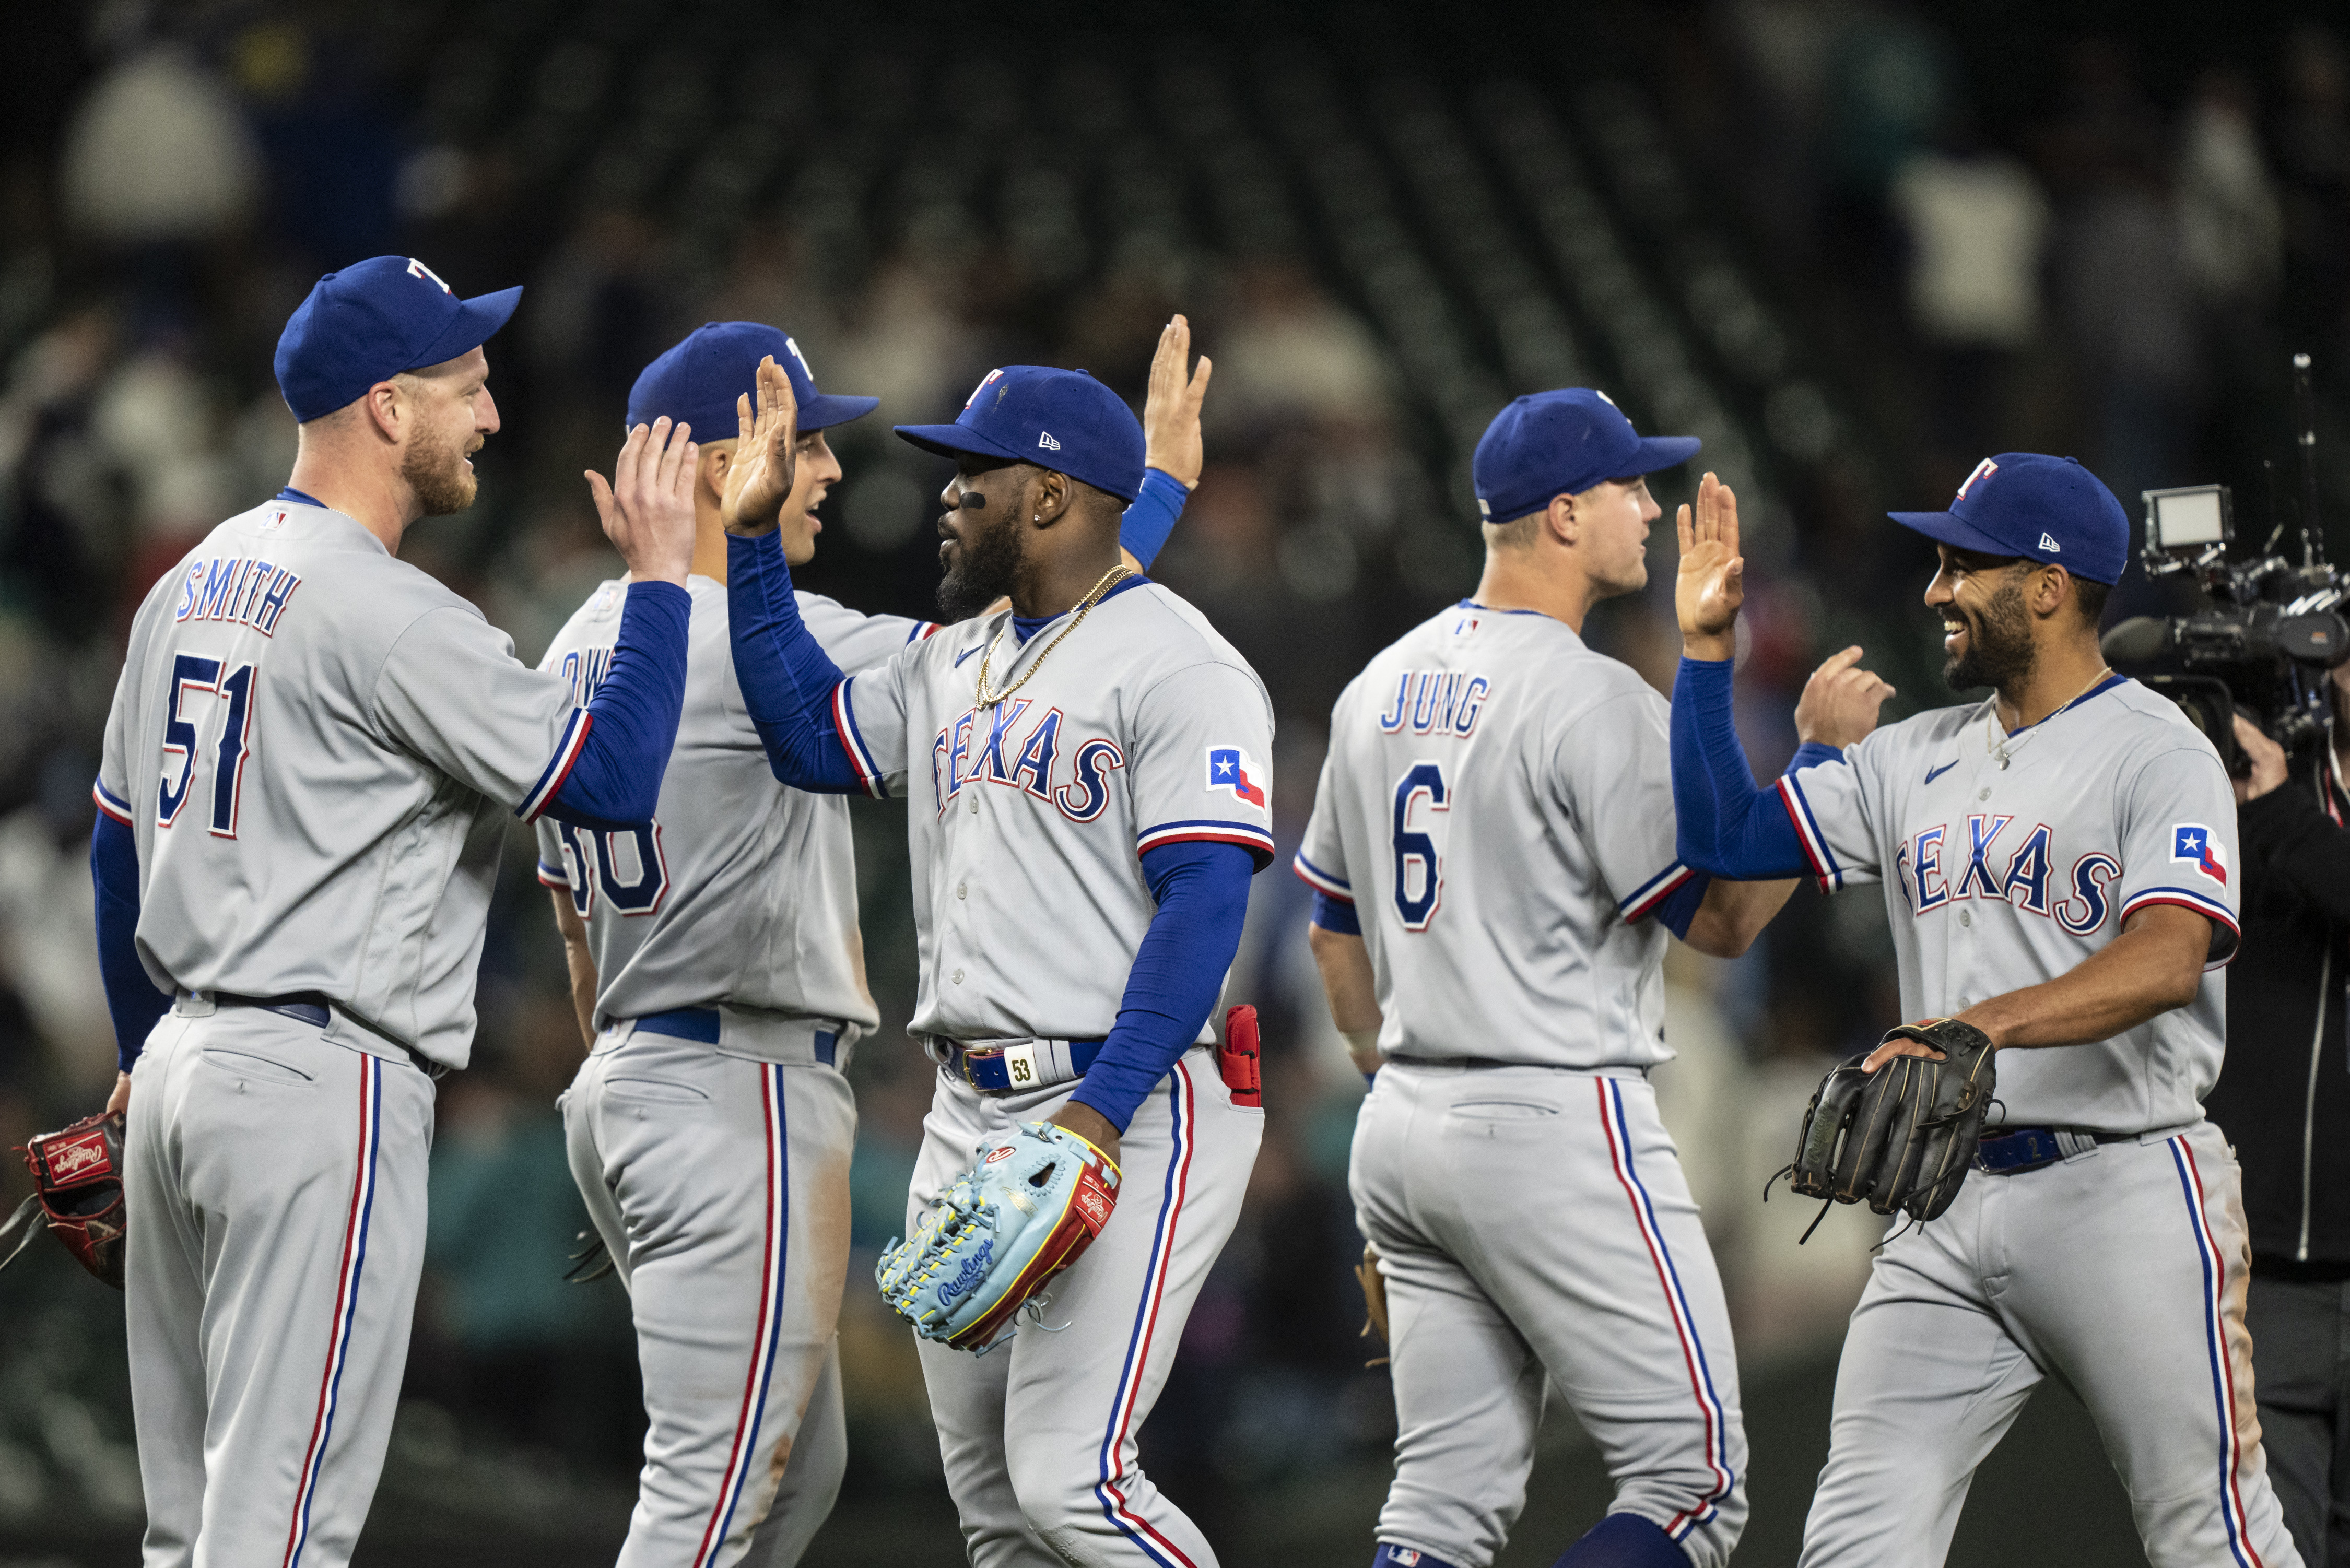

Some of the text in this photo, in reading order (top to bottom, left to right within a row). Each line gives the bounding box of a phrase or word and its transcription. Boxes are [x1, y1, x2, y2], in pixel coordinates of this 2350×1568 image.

[1957, 457, 1999, 501] T
[177, 556, 302, 639] SMITH
[1378, 668, 1491, 739] JUNG
[157, 650, 257, 840] 51
[931, 697, 1125, 824] TEXAS
[1389, 759, 1450, 932] 6
[1012, 1058, 1031, 1082] 53
[54, 1144, 103, 1174] Rawlings
[2028, 1137, 2041, 1159] 2
[1080, 1192, 1108, 1223] Rawlings
[938, 1238, 994, 1306] Rawlings
